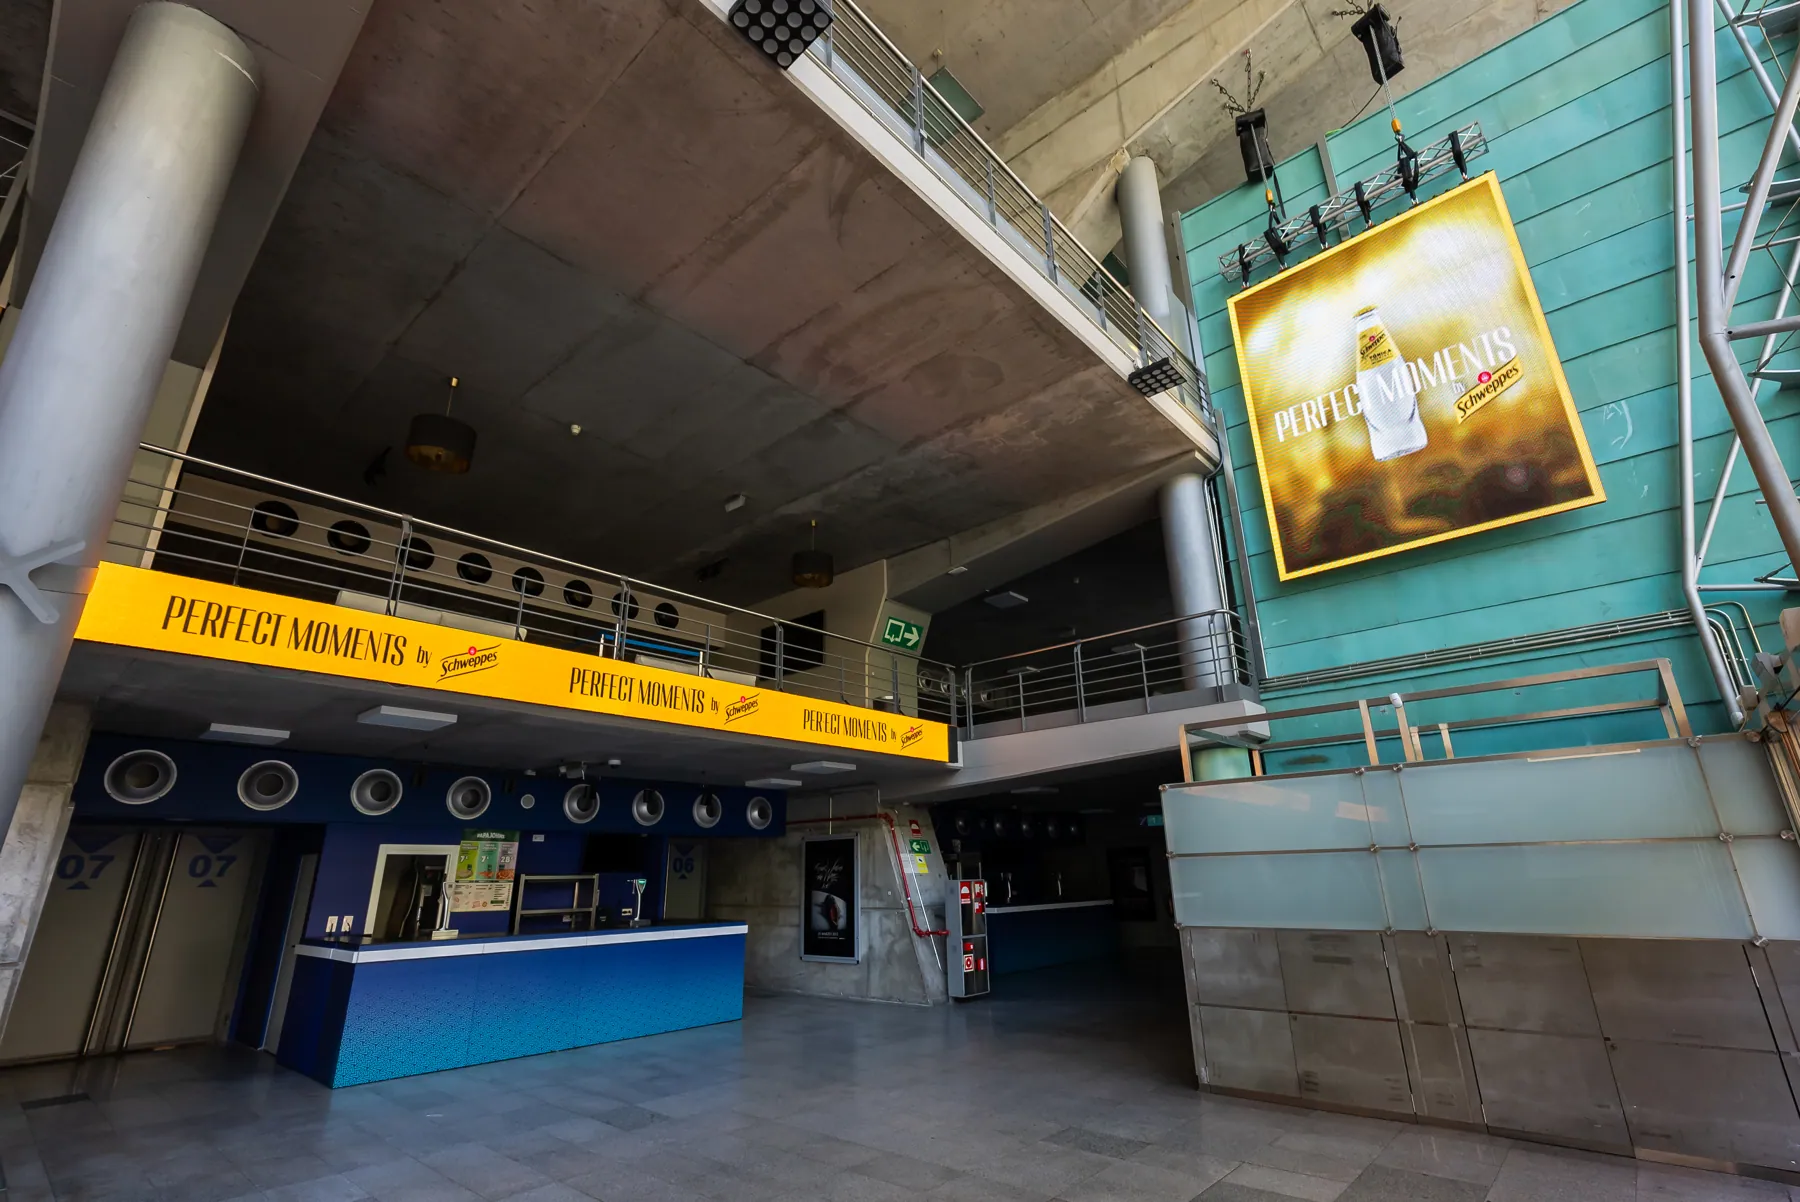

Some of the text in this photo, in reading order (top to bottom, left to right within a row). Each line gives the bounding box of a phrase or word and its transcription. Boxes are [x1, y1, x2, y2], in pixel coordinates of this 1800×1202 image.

[1376, 326, 1518, 405] MOMENTS
[1457, 365, 1519, 419] Schweppes
[162, 595, 498, 677] PERFECT MOMENTS by Schweppes
[569, 667, 759, 721] PERFECT MOMENTS by Schweppes
[803, 708, 842, 735] PERECT
[843, 715, 887, 742] MOMENTS
[890, 728, 897, 742] by
[56, 854, 115, 880] 07
[188, 854, 237, 878] 07
[672, 857, 695, 874] 06
